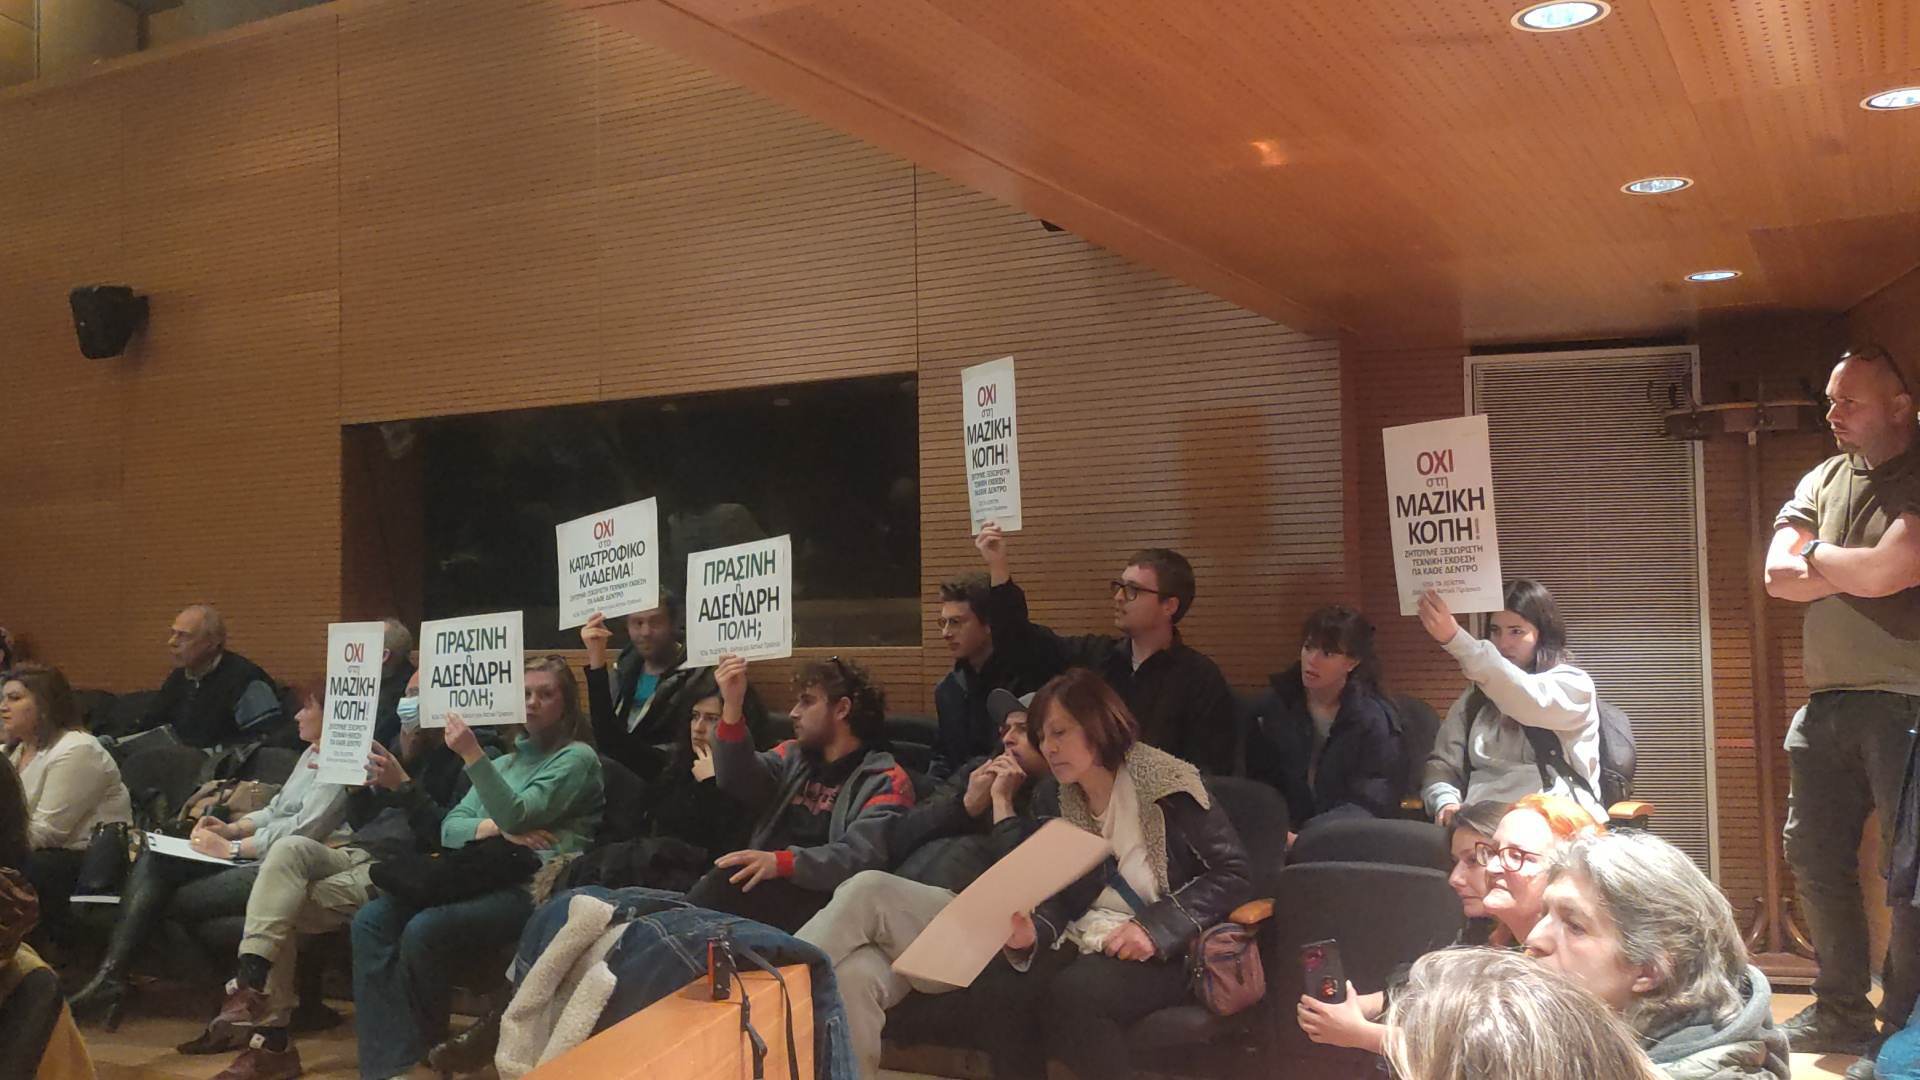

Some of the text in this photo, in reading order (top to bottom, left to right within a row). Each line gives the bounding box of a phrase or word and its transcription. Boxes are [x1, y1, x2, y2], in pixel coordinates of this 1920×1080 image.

[978, 383, 997, 408] ΟΧΙ
[967, 416, 1012, 446] ΜΑΖΙΚΗ
[972, 443, 1009, 470] ΚΟΠΗ!
[1416, 449, 1454, 476] ΟΧΙ
[1426, 476, 1449, 488] στη
[1396, 487, 1486, 519] ΜΑΖΙΚΗ
[593, 518, 615, 540] ΟΧΙ
[1408, 517, 1480, 545] ΚΟΠΗ!
[569, 540, 646, 574] ΚΑΤΑΣΤΡΟΦΙΚΟ
[704, 549, 776, 586] ΠΡΑΣΙΝΗ
[1445, 564, 1479, 574] ΔΕΝΤΡΟ
[579, 561, 634, 589] ΚΛΑΔΕΜΑ!
[698, 585, 780, 623] ΑΔΕΝΔΡΗ
[436, 626, 507, 655] ΠΡΑΣΙΝΗ
[718, 618, 762, 642] ΠΟΛΗ;
[344, 643, 365, 663] ΟΧΙ
[330, 677, 376, 697] ΜΑΖΙΚΗ
[431, 660, 512, 689] ΑΔΕΝΔΡΗ
[333, 701, 370, 720] ΚΟΠΗ!
[449, 688, 494, 710] ΠΟΛΗ;
